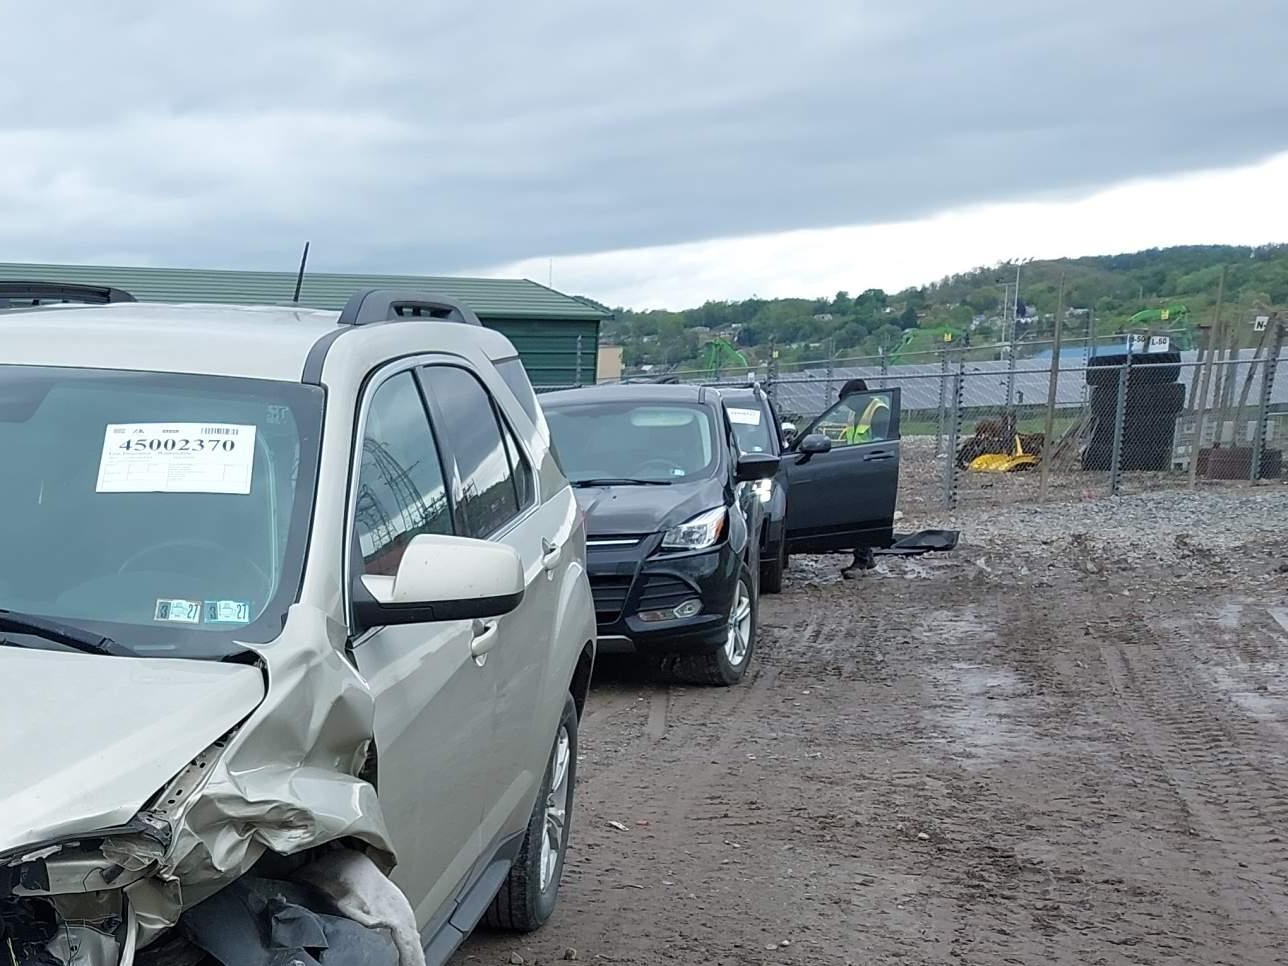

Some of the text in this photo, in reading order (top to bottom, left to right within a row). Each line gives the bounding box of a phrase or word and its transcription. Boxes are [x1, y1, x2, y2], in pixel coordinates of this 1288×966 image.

[1129, 335, 1146, 343] -50
[119, 438, 235, 452] 45002370
[159, 605, 168, 619] 3
[187, 603, 199, 619] 27
[236, 603, 247, 619] 27
